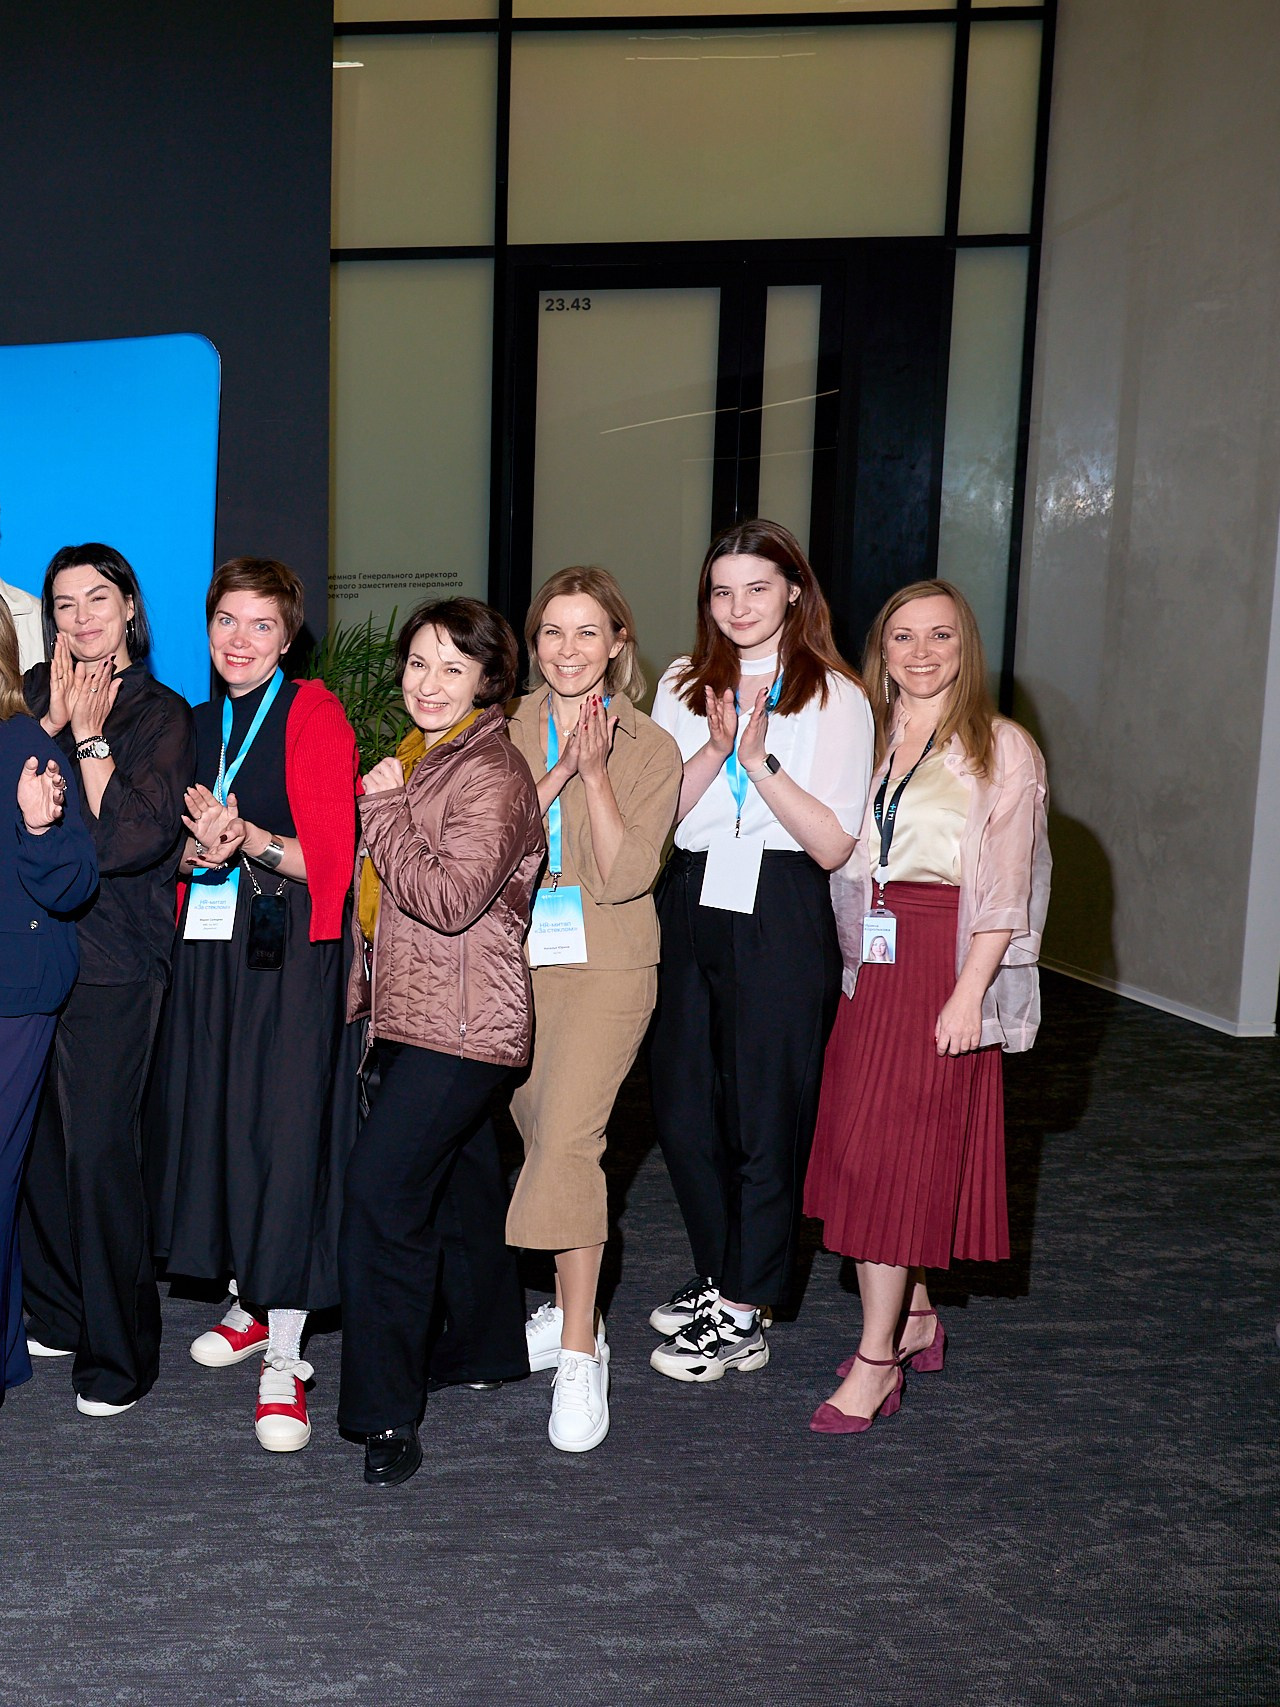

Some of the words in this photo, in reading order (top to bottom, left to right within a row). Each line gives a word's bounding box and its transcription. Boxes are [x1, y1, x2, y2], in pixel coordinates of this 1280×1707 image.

[545, 297, 592, 311] 23.43
[414, 572, 458, 580] директора
[408, 581, 463, 589] генерального
